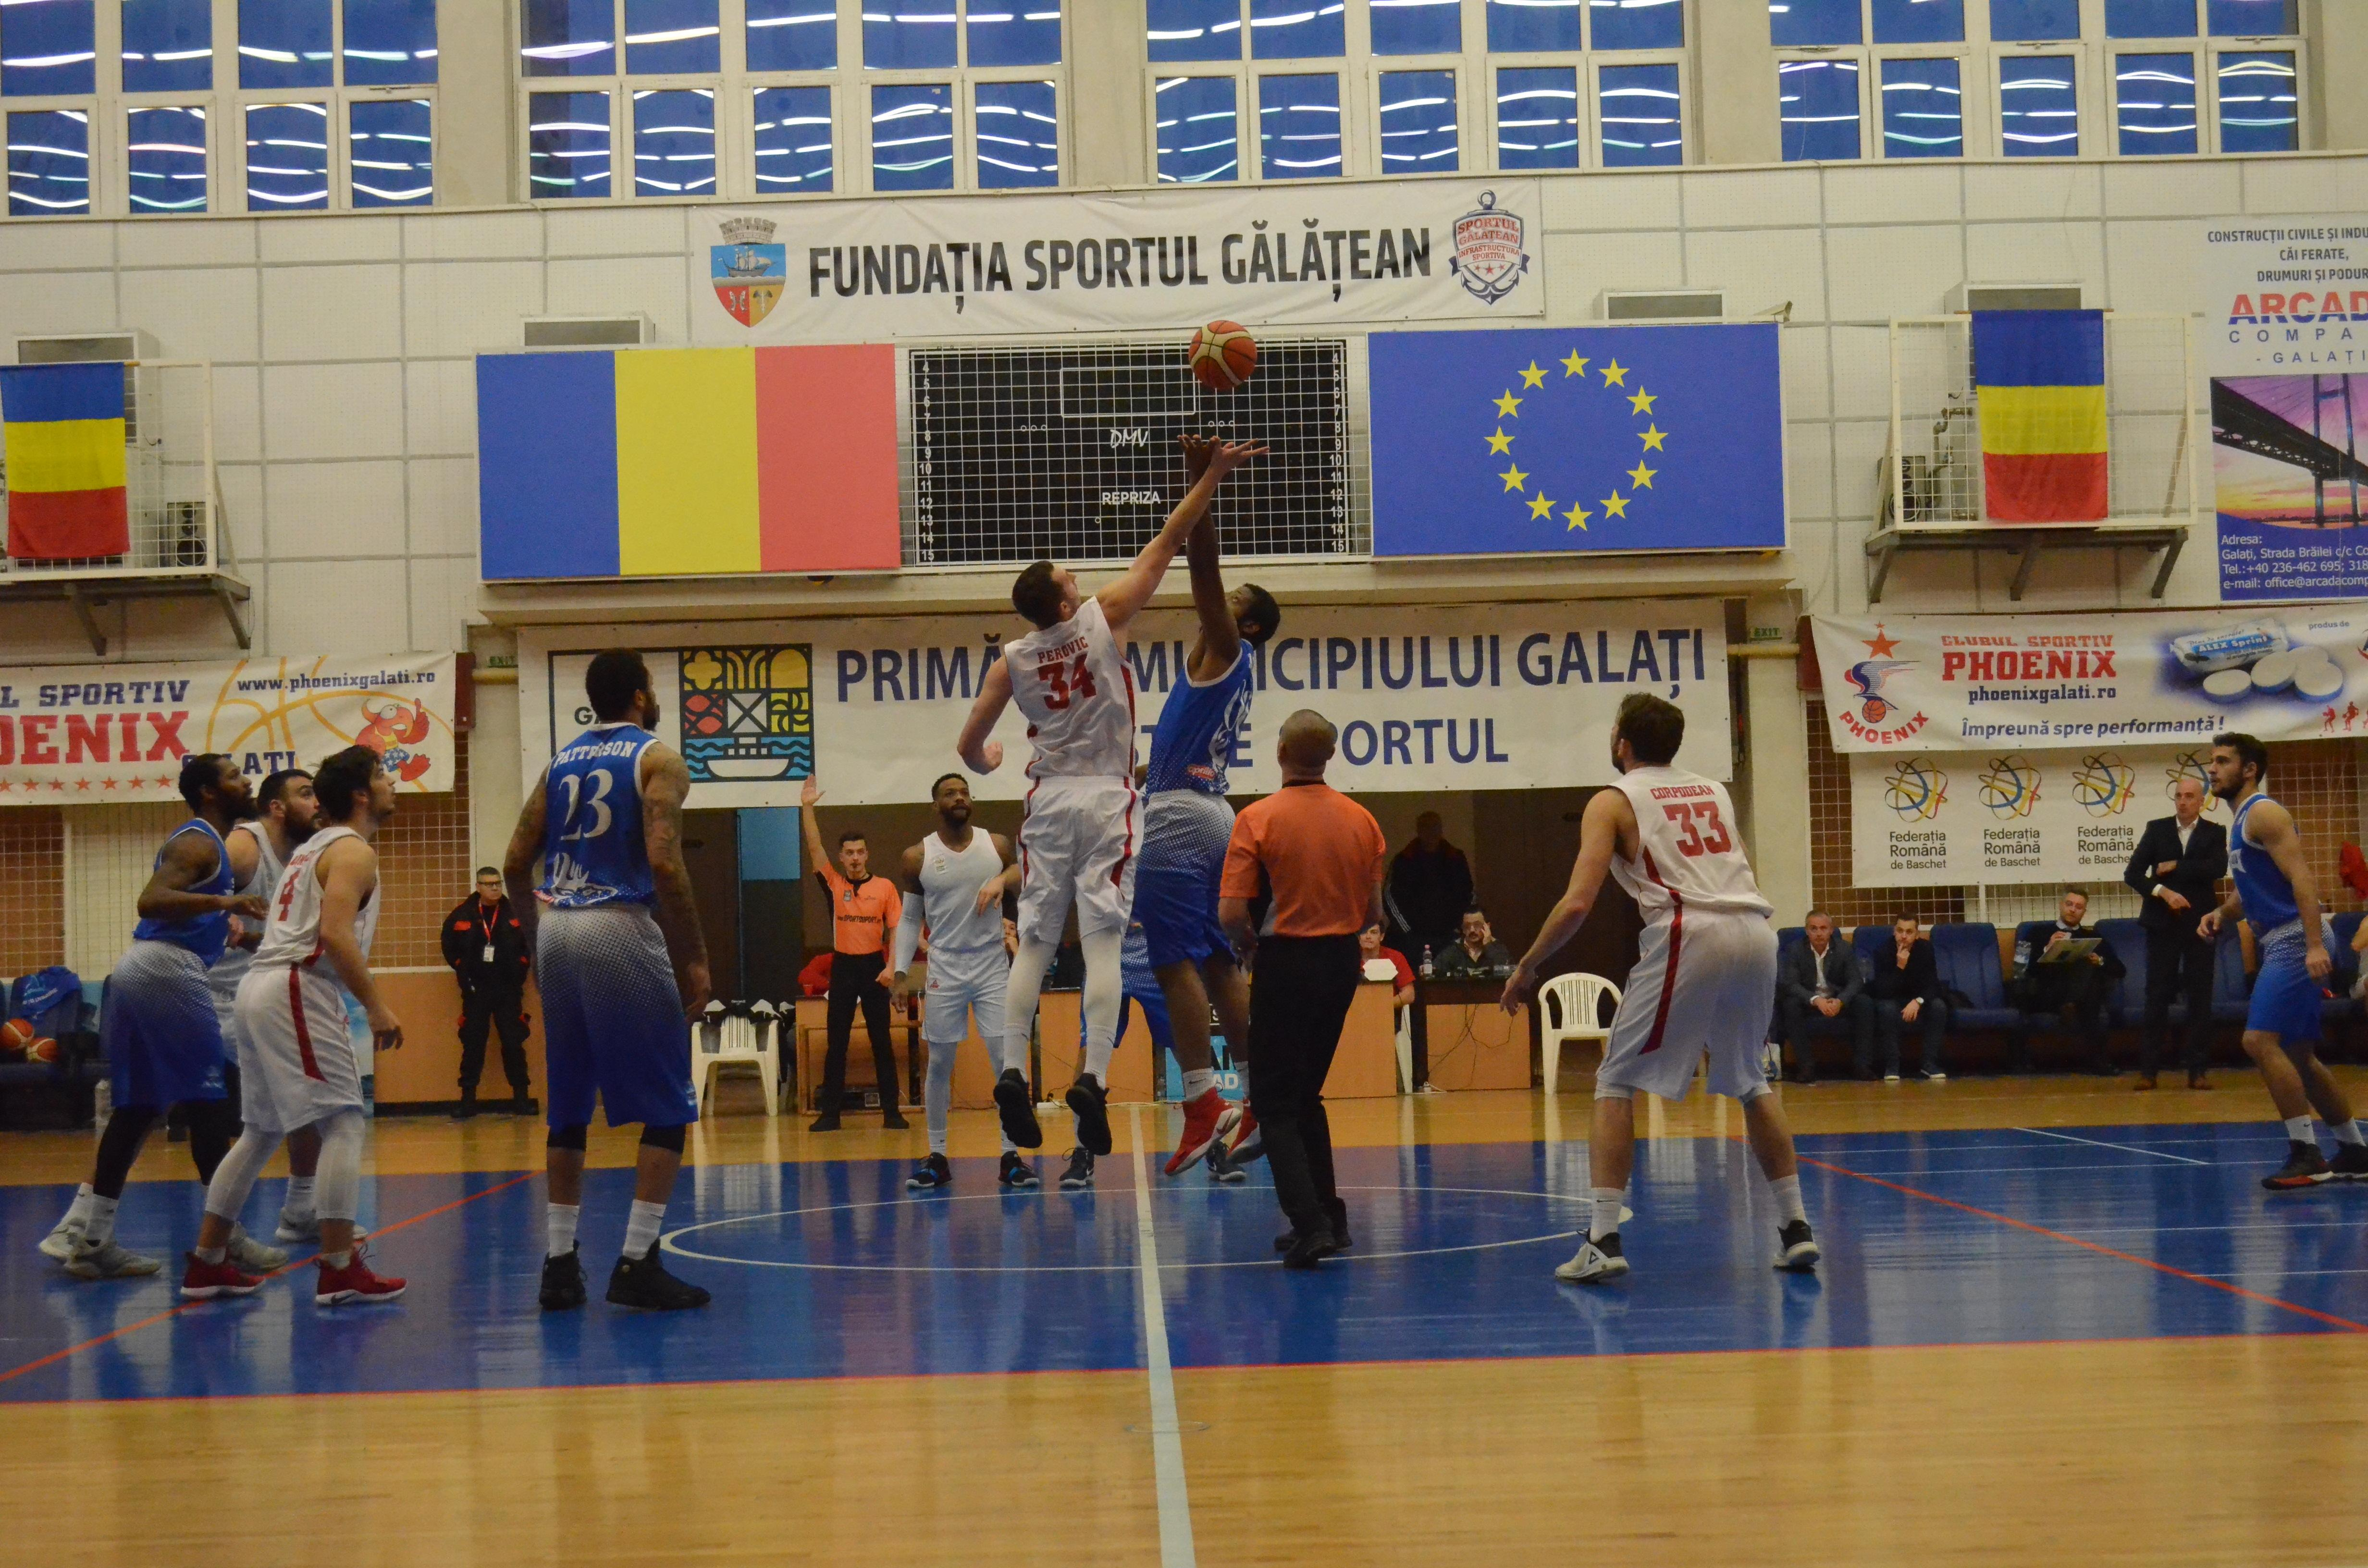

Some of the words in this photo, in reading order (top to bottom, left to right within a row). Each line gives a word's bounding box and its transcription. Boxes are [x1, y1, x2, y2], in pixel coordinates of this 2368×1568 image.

[1458, 218, 1518, 234] SPORTUL
[2288, 228, 2324, 240] CIVILE
[1459, 245, 1519, 257] INFRASTRUCTURA
[1472, 252, 1505, 260] SPORTIVA
[2280, 247, 2298, 261] CĂI
[2301, 248, 2348, 260] FERATE,
[808, 242, 1011, 314] FUNDAȚIA
[1026, 236, 1208, 291] SPORTUL
[1221, 218, 1430, 302] GĂLĂȚEAN
[2257, 270, 2311, 282] DRUMURI
[1332, 353, 1338, 364] 4
[923, 362, 929, 372] 4
[1333, 370, 1339, 381] 5
[924, 379, 930, 390] 5
[1334, 388, 1340, 398] 6
[924, 396, 930, 407] 6
[1334, 404, 1340, 416] 7
[924, 413, 930, 424] 7
[1335, 422, 1341, 433] 8
[925, 431, 931, 441] 8
[1335, 439, 1341, 450] 9
[925, 448, 931, 459] 9
[1330, 455, 1342, 466] 10
[920, 464, 932, 475] 10
[1331, 472, 1342, 483] 11
[921, 481, 931, 490] 11
[1102, 491, 1160, 505] REPRIZA
[1331, 489, 1343, 500] 12
[921, 498, 932, 509] 12
[1331, 506, 1343, 517] 13
[921, 515, 933, 526] 13
[1332, 524, 1343, 534] 14
[921, 532, 933, 543] 14
[2221, 535, 2262, 545] Adresa:
[1332, 541, 1344, 551] 15
[922, 550, 934, 561] 15
[2260, 548, 2295, 558] Strada
[2272, 562, 2317, 573] 236-462
[2224, 577, 2260, 588] e-mail:
[2308, 622, 2338, 630] produs
[1754, 627, 1779, 637] EXIT
[1941, 635, 2018, 647] CLUBUL
[2027, 635, 2113, 648] SPORTIV
[2199, 642, 2228, 651] ALEX
[1037, 636, 1088, 663] PEROVIC
[1517, 628, 1704, 699] GALAȚI
[1942, 650, 2116, 681] PHOENIX
[238, 670, 435, 692] www.phoenixgalati.ro
[1037, 653, 1096, 710] 34
[39, 680, 190, 707] SPORTIV
[1969, 685, 2116, 705] phoenixgalati.ro
[1838, 710, 1929, 745] PHOENIX
[1962, 717, 2049, 737] Împreună
[2053, 721, 2092, 738] spre
[553, 741, 637, 767] PATTERSON
[1650, 784, 1715, 800] CORPODEAN
[558, 769, 614, 841] 23
[1662, 801, 1731, 857] 33
[2077, 826, 2133, 838] Federația
[1889, 830, 1946, 844] Federația
[1984, 828, 2040, 842] Federația
[1984, 840, 2040, 855] Română
[2078, 838, 2134, 851] Română
[1890, 843, 1946, 858] Română
[1890, 860, 1903, 869] de
[1906, 859, 1946, 869] Baschet
[1985, 858, 1997, 867] de
[2000, 857, 2040, 867] Baschet
[2079, 856, 2091, 865] de
[2094, 854, 2130, 863] Basche
